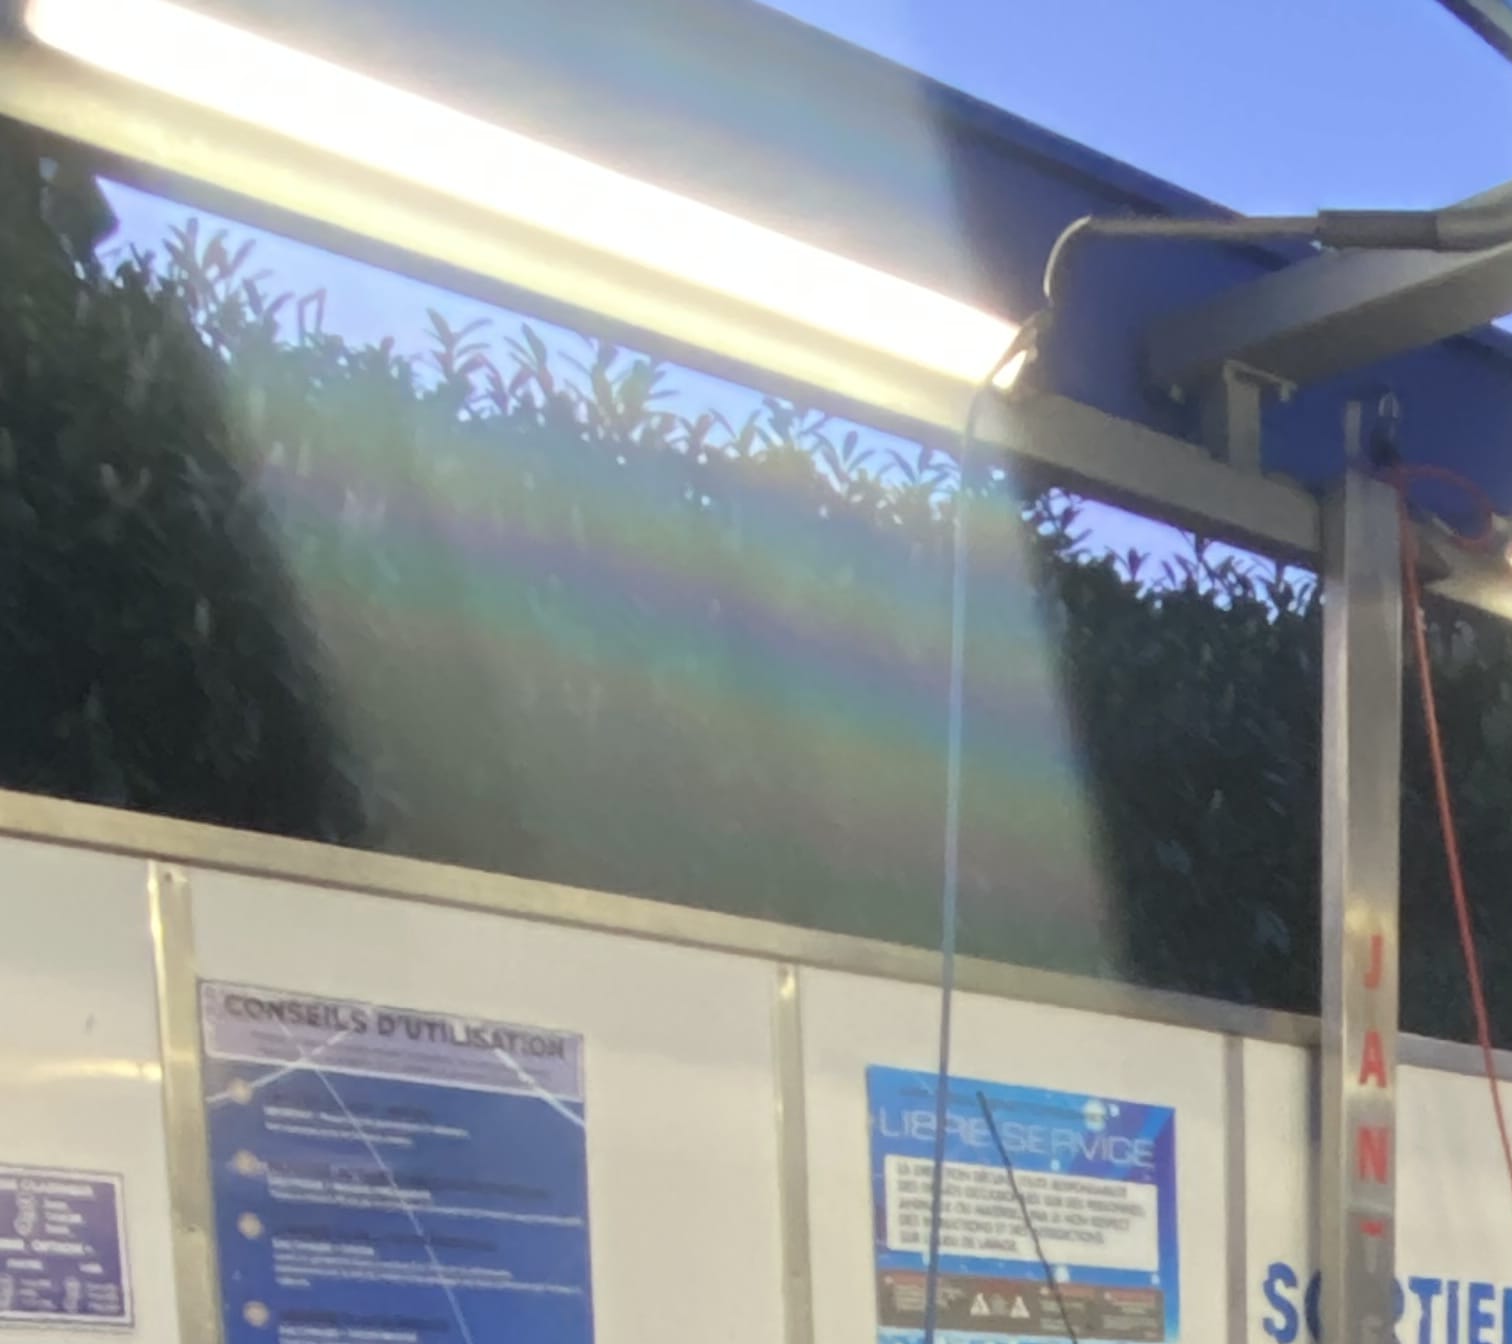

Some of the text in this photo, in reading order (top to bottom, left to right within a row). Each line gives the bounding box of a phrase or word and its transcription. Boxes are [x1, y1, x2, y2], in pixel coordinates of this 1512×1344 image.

[223, 995, 368, 1034] CONSEILS
[377, 1014, 567, 1060] D'UTILISATION
[879, 1106, 1156, 1170] LIBRE SERVICE
